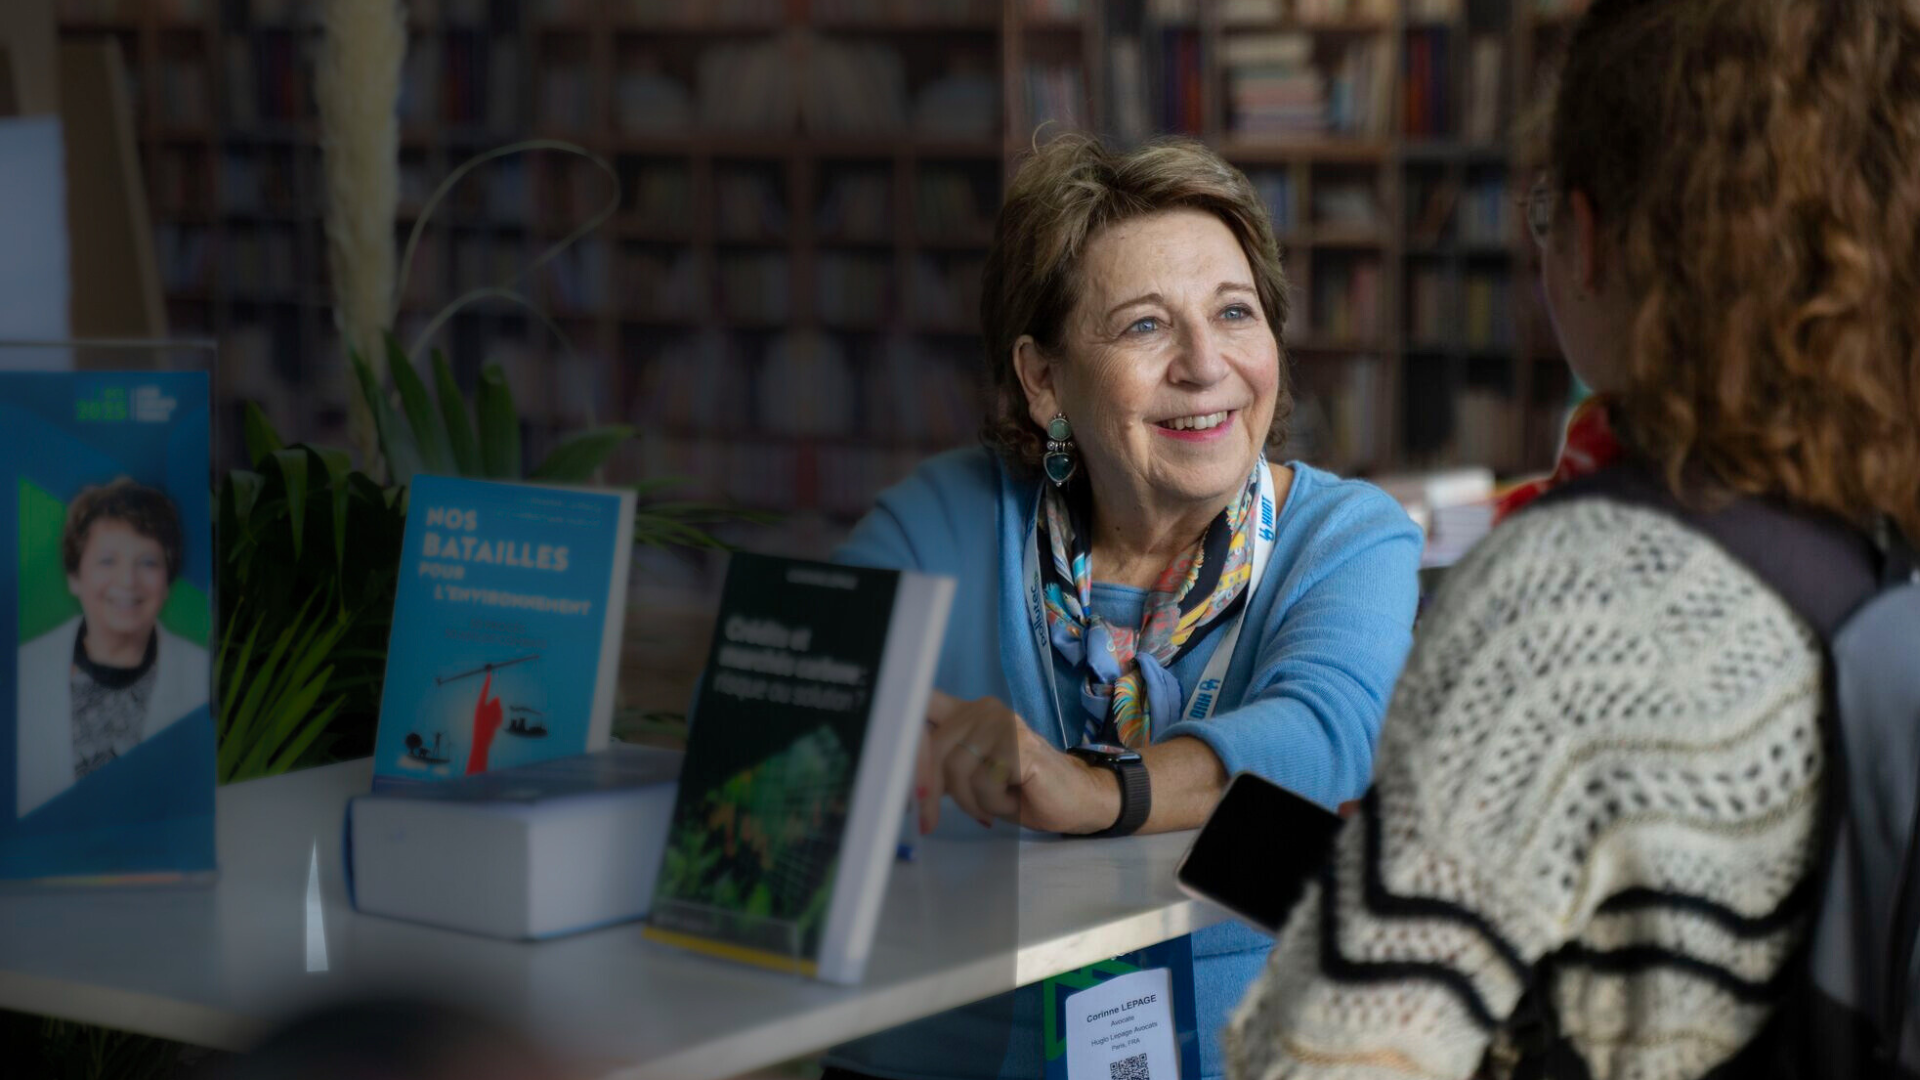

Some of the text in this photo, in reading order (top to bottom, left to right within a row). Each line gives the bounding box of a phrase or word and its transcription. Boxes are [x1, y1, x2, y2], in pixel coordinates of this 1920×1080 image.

[425, 505, 478, 532] NOS
[422, 530, 570, 572] BATAILLES
[418, 560, 466, 580] POUR
[433, 583, 592, 616] L'ENVIRONNEMENT
[1030, 586, 1048, 647] pollutec
[1086, 994, 1157, 1024] Corinne LEPAGE
[1110, 1015, 1135, 1027] Avocate
[1110, 1030, 1133, 1042] Lepage
[1134, 1021, 1158, 1033] Avocats
[1128, 1038, 1140, 1047] FRA
